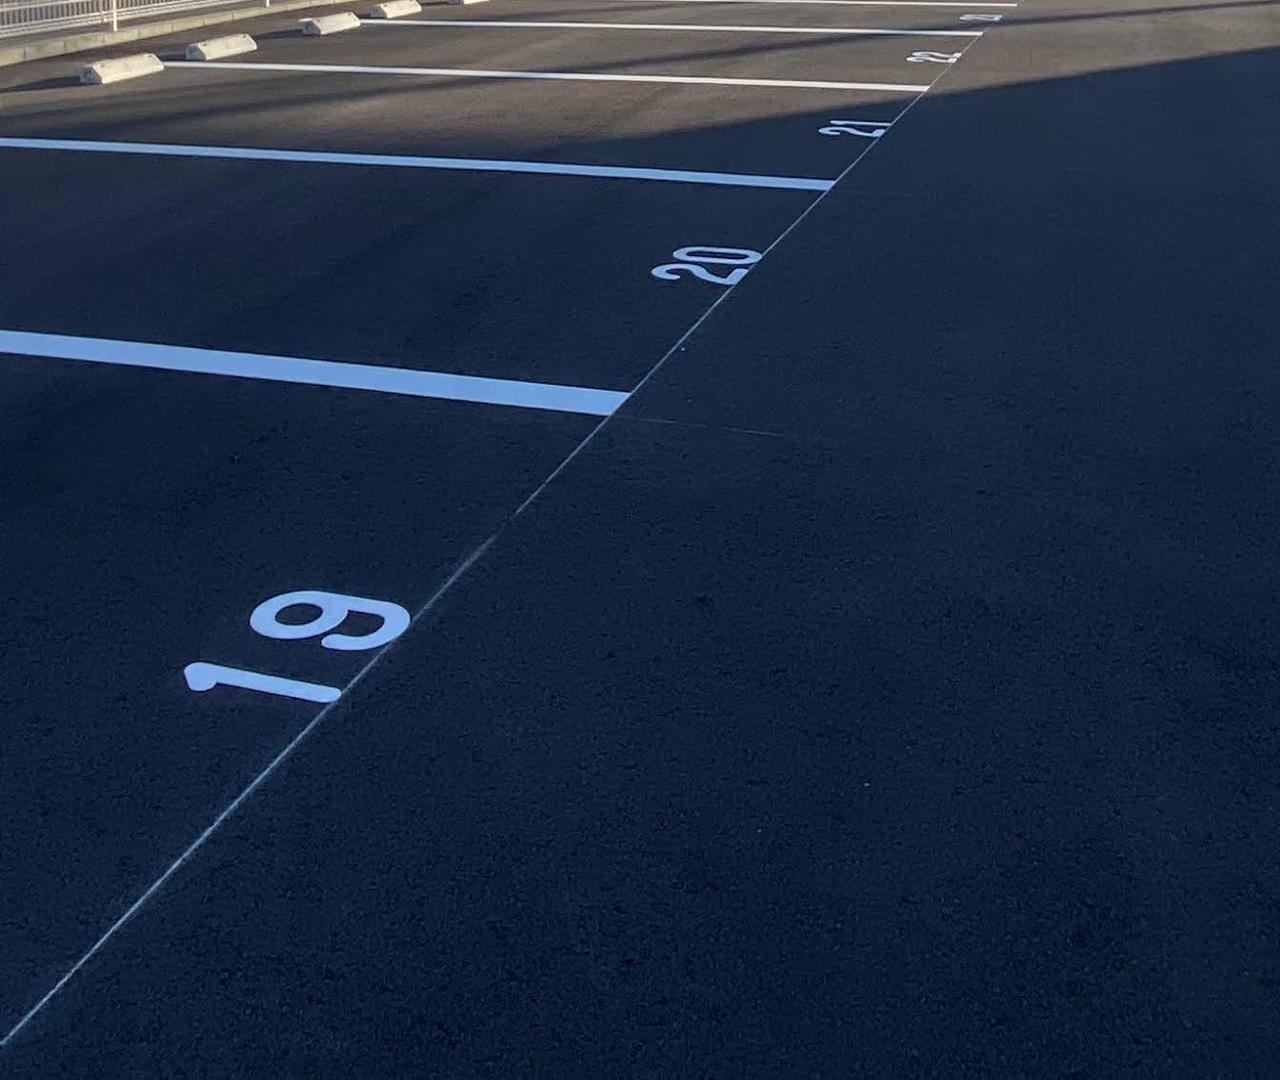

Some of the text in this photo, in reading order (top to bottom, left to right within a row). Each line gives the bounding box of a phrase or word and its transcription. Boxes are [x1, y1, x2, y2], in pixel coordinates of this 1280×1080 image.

[818, 120, 893, 138] 21
[651, 246, 763, 286] 20
[183, 590, 411, 703] 19
